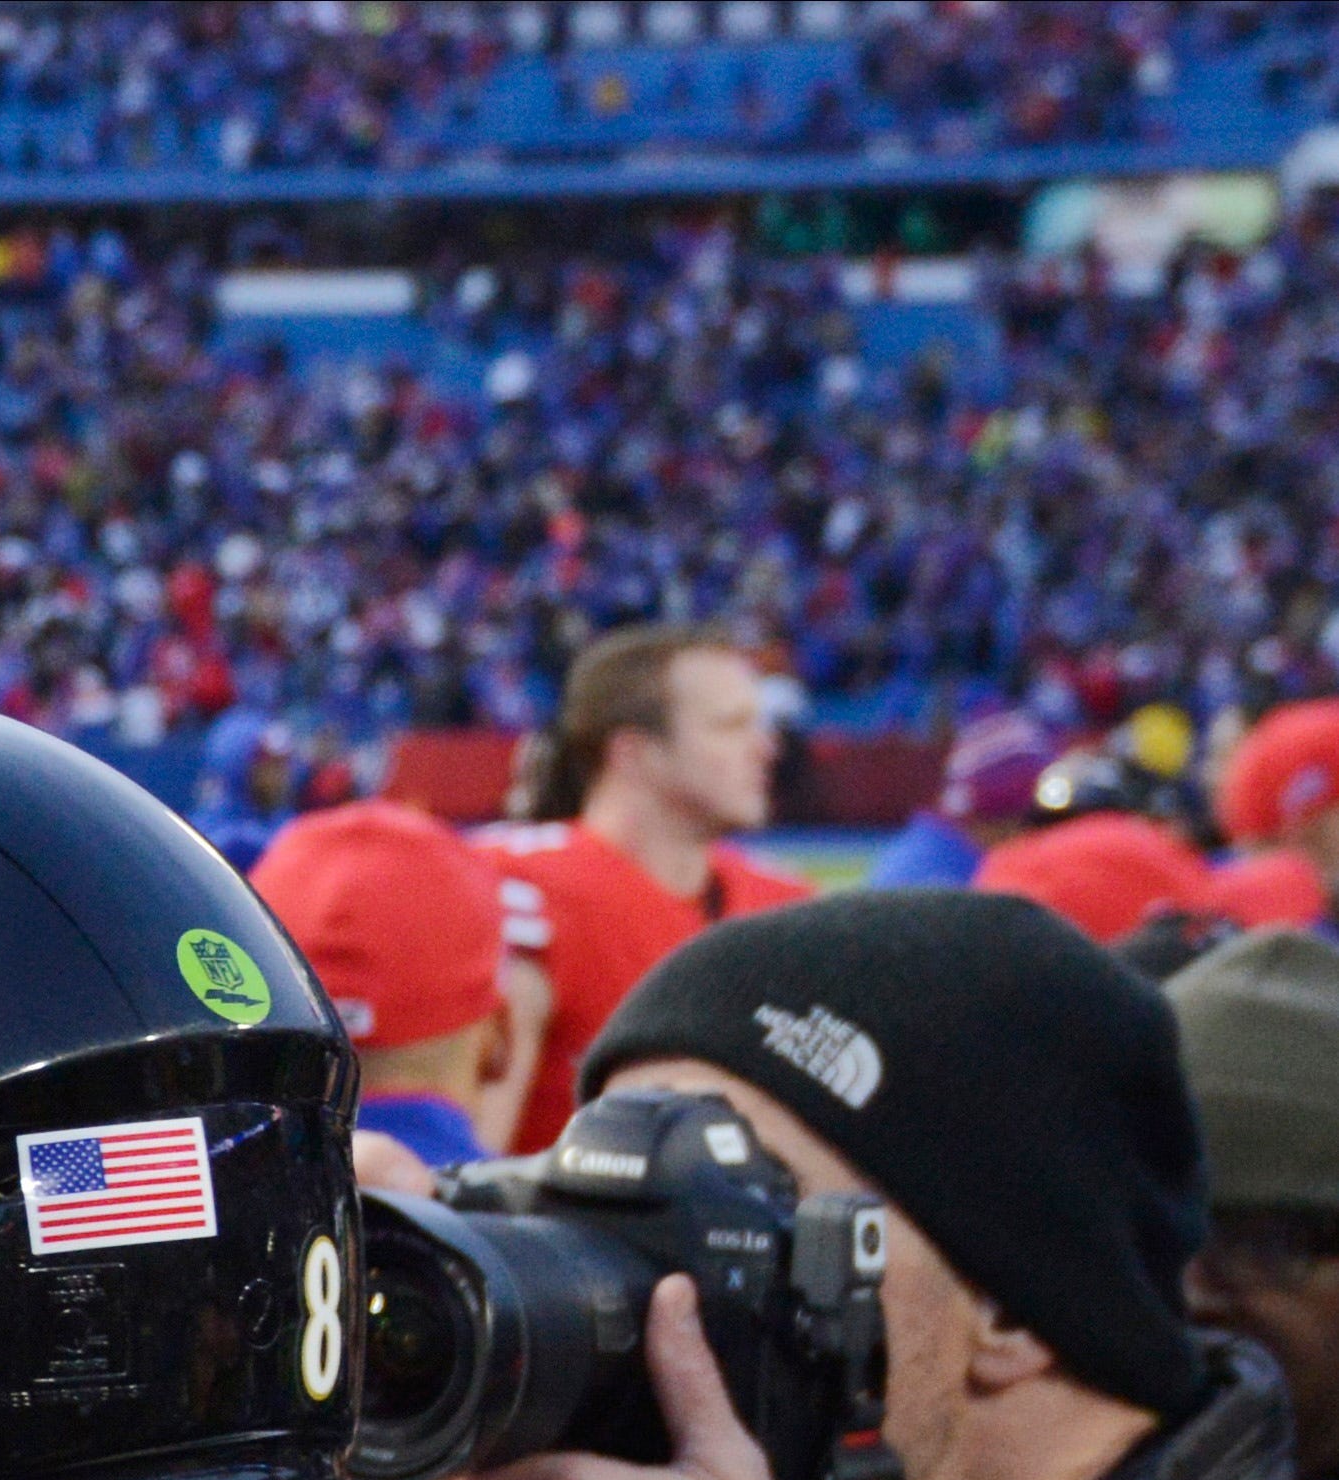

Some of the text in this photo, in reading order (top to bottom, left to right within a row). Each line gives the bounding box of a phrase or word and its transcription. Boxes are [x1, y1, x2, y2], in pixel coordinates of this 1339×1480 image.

[204, 959, 242, 986] NFL
[753, 1002, 841, 1058] NORTH
[809, 1005, 855, 1042] THE
[764, 1028, 829, 1080] FACE
[560, 1146, 648, 1180] Canon
[302, 1235, 341, 1401] 8
